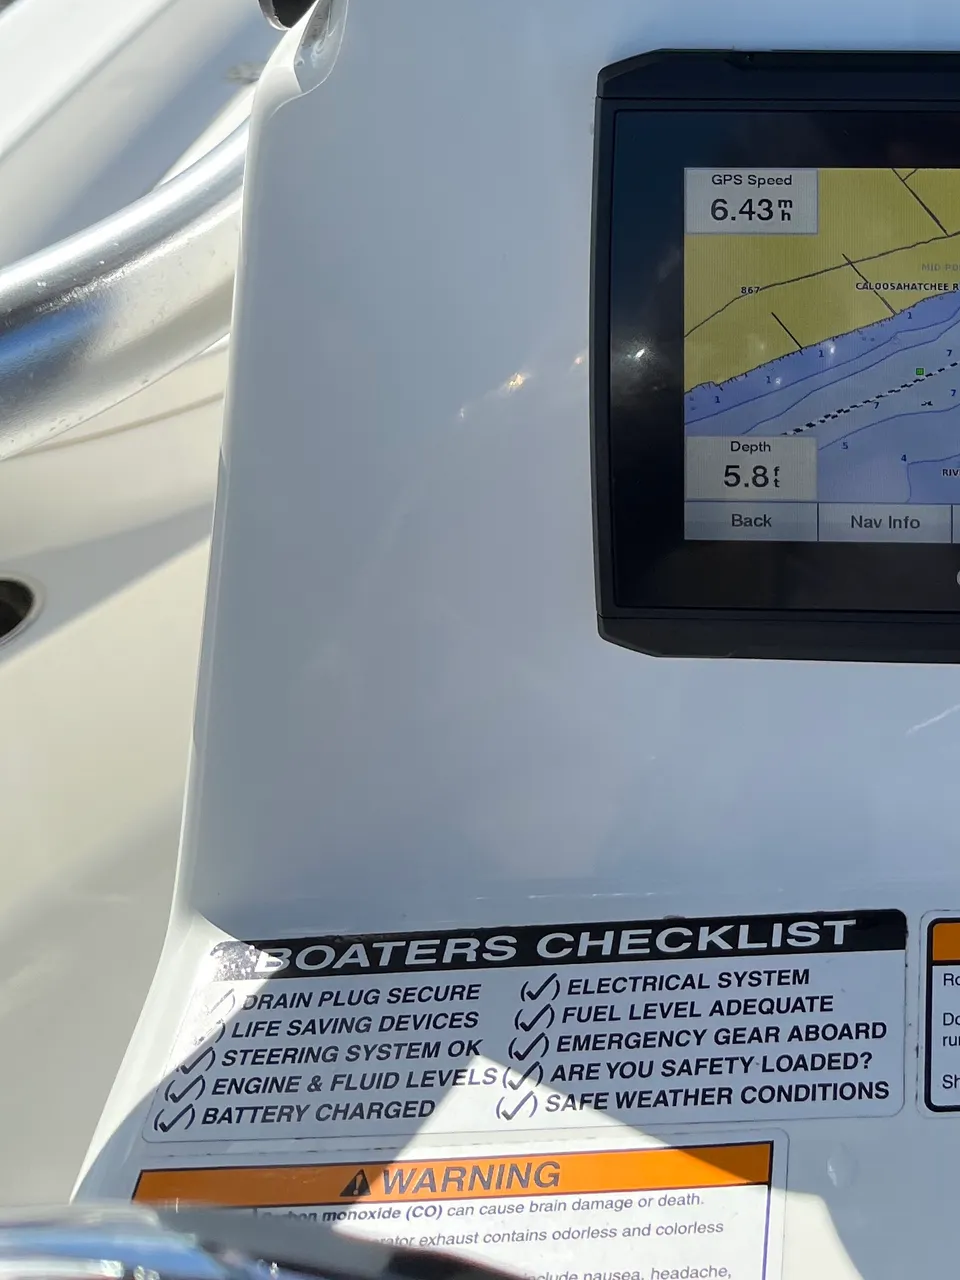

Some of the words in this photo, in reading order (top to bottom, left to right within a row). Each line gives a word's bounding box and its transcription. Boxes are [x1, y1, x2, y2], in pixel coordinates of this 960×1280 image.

[711, 174, 742, 186] GPS
[748, 174, 792, 188] Speed
[710, 198, 774, 221] 6.43
[741, 286, 760, 294] 867
[855, 282, 949, 292] CALOOSAHATCHEE
[730, 441, 771, 455] Depth
[723, 465, 769, 488] 5.8
[731, 513, 772, 528] Back
[851, 515, 882, 529] Nav
[888, 515, 921, 529] Info
[254, 935, 518, 972] BOATERS
[536, 919, 857, 958] CHECKLIST
[567, 973, 711, 996] ELECTRICAL
[717, 968, 810, 988] SYSTEM
[242, 992, 313, 1010] DRAIN
[318, 988, 381, 1007] PLUG
[386, 984, 482, 1005] SECURE
[562, 1004, 622, 1024] FUEL
[628, 1000, 702, 1020] LEVEL
[708, 995, 834, 1017] ADEQUATE
[231, 1021, 280, 1038] LIFE
[287, 1017, 372, 1036] SAVING
[378, 1011, 480, 1032] DEVICES
[556, 1028, 707, 1053] EMERGENCY
[713, 1026, 781, 1045] GEAR
[787, 1021, 888, 1043] ABOARD
[221, 1045, 339, 1067] STEERING
[345, 1041, 443, 1063] SYSTEM
[447, 1039, 483, 1058] OK
[550, 1063, 600, 1082] ARE
[607, 1060, 654, 1080] YOU
[660, 1055, 754, 1078] SAFETY
[761, 1051, 873, 1073] LOADED?
[211, 1073, 302, 1095] ENGINE
[306, 1074, 323, 1092] &
[330, 1071, 399, 1091] FLUID
[405, 1067, 498, 1088] LEVELS
[545, 1091, 609, 1113] SAFE
[615, 1086, 733, 1109] WEATHER
[740, 1080, 890, 1104] CONDITIONS
[201, 1104, 310, 1126] BATTERY
[315, 1100, 436, 1121] CHARGED
[382, 1161, 561, 1195] WARNING
[322, 1207, 401, 1222] monoxide
[406, 1205, 443, 1221] (CO)
[447, 1205, 475, 1217] can
[479, 1202, 524, 1216] cause
[529, 1200, 567, 1213] brain
[571, 1197, 633, 1212] damage
[638, 1197, 654, 1208] or
[658, 1193, 704, 1207] death.
[419, 1233, 479, 1247] exhaust
[483, 1229, 547, 1244] contains
[552, 1225, 617, 1241] odorless
[622, 1223, 651, 1237] and
[655, 1221, 724, 1237] colorless
[651, 1265, 731, 1280] headache,
